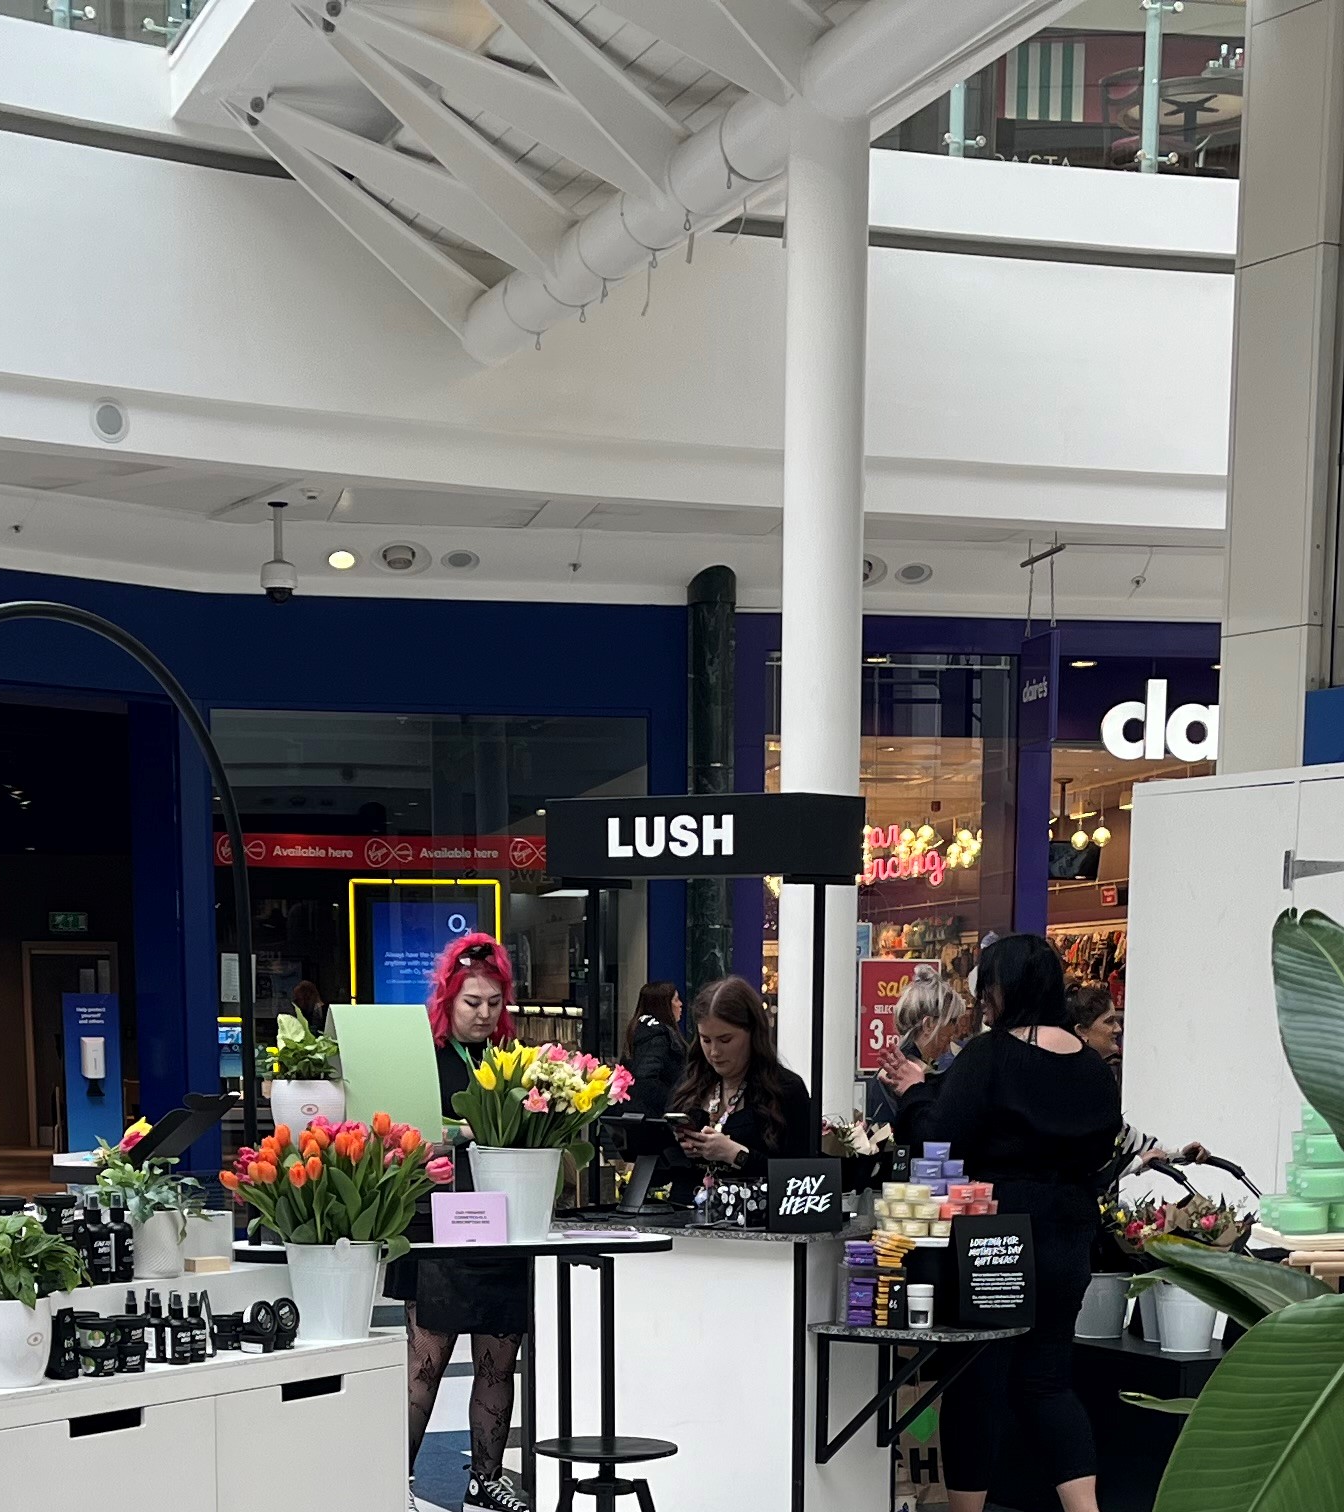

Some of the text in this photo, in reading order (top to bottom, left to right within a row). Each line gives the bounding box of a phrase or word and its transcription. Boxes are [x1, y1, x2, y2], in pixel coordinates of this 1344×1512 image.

[1022, 676, 1048, 703] claire's
[607, 814, 734, 858] LUSH
[273, 845, 354, 858] Available here
[419, 847, 471, 859] Available
[473, 847, 499, 859] here
[877, 975, 914, 998] sal
[869, 1019, 902, 1049] 3 FO
[786, 1174, 826, 1196] PAY
[779, 1192, 833, 1216] HERE
[968, 1243, 1024, 1257] MOTHER'S DAY
[969, 1235, 1019, 1247] LOOKING FOR
[974, 1256, 992, 1267] GIFT
